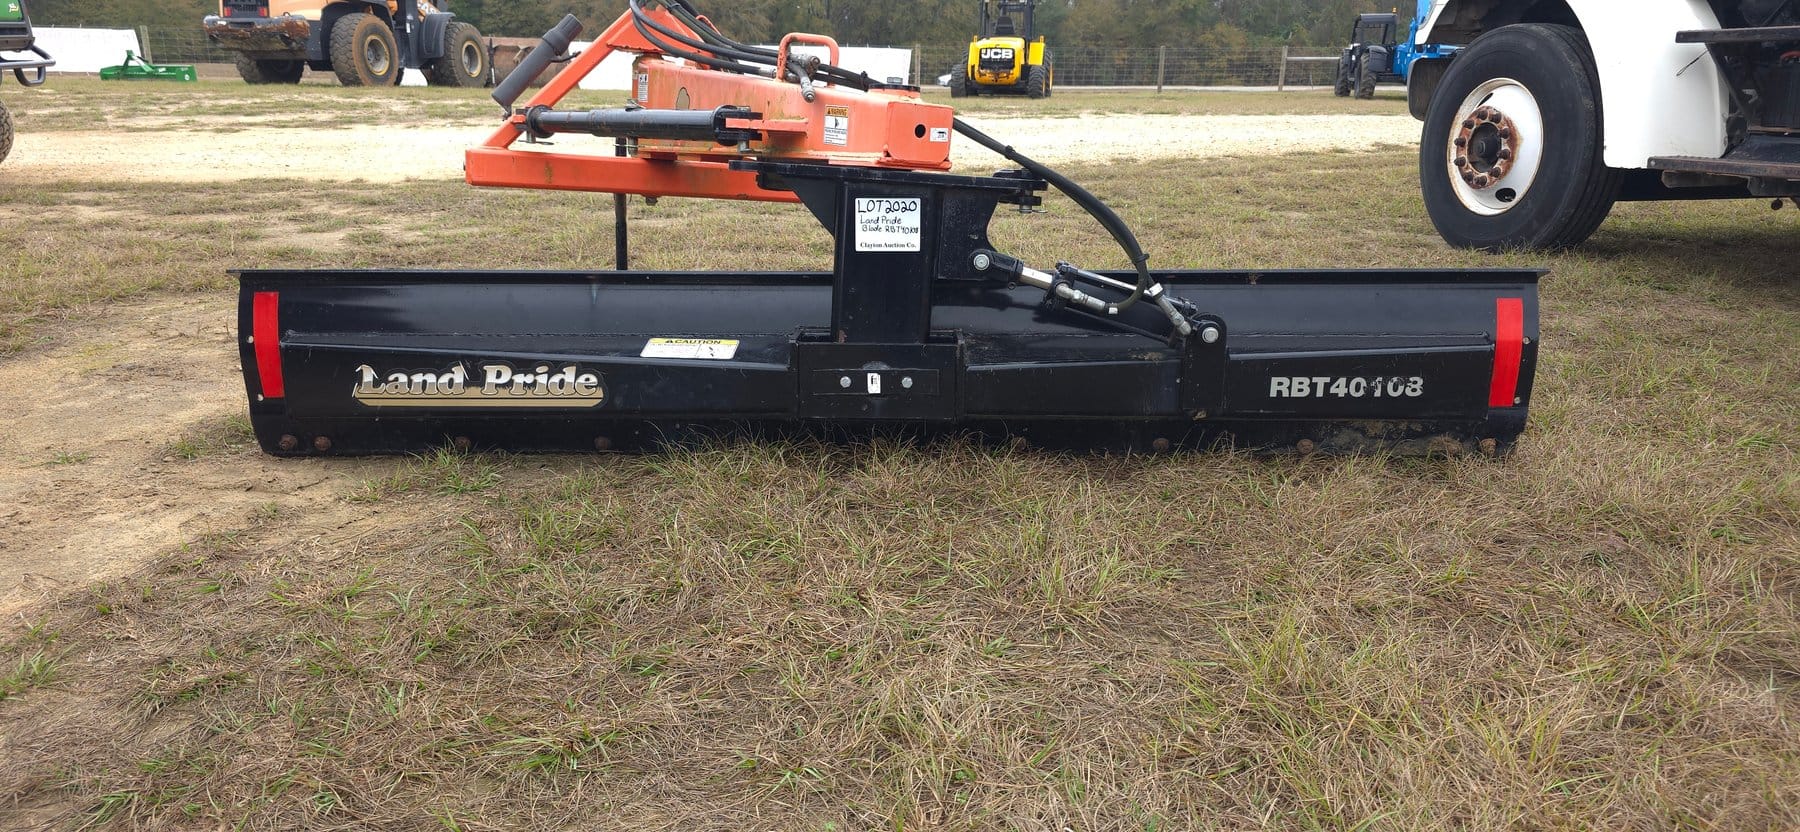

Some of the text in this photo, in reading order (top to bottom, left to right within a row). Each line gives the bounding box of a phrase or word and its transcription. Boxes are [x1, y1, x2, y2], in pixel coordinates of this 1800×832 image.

[981, 48, 1013, 59] JCB
[860, 215, 902, 224] Land Pride
[355, 364, 600, 397] Land Pride
[1269, 376, 1424, 398] RBT40108
